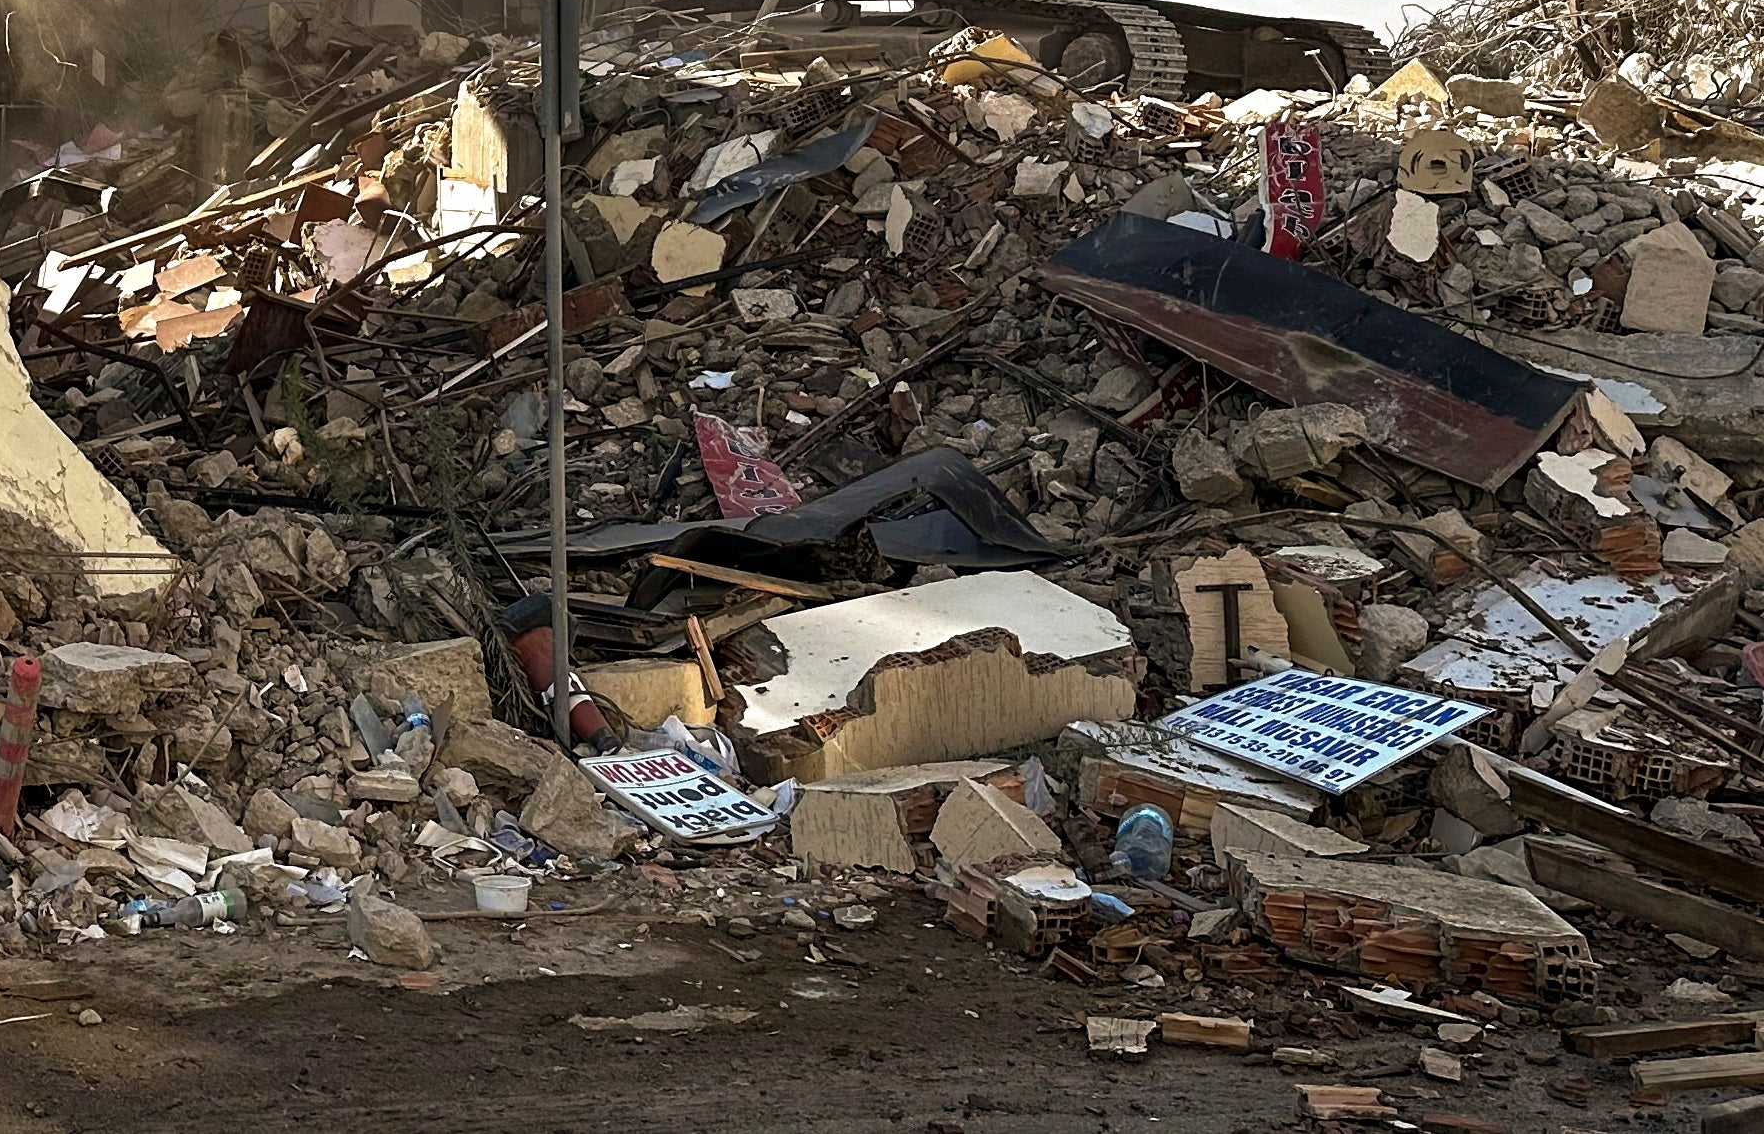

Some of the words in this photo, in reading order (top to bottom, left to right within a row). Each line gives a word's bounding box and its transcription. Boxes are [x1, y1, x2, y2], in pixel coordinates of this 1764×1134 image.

[1222, 687, 1317, 714] SERBEST
[1268, 674, 1366, 700] YAŞAR
[1353, 691, 1468, 726] ERCAN
[1299, 760, 1329, 774] 06
[1325, 769, 1356, 782] 97
[629, 777, 728, 810] point
[660, 800, 768, 831] black
